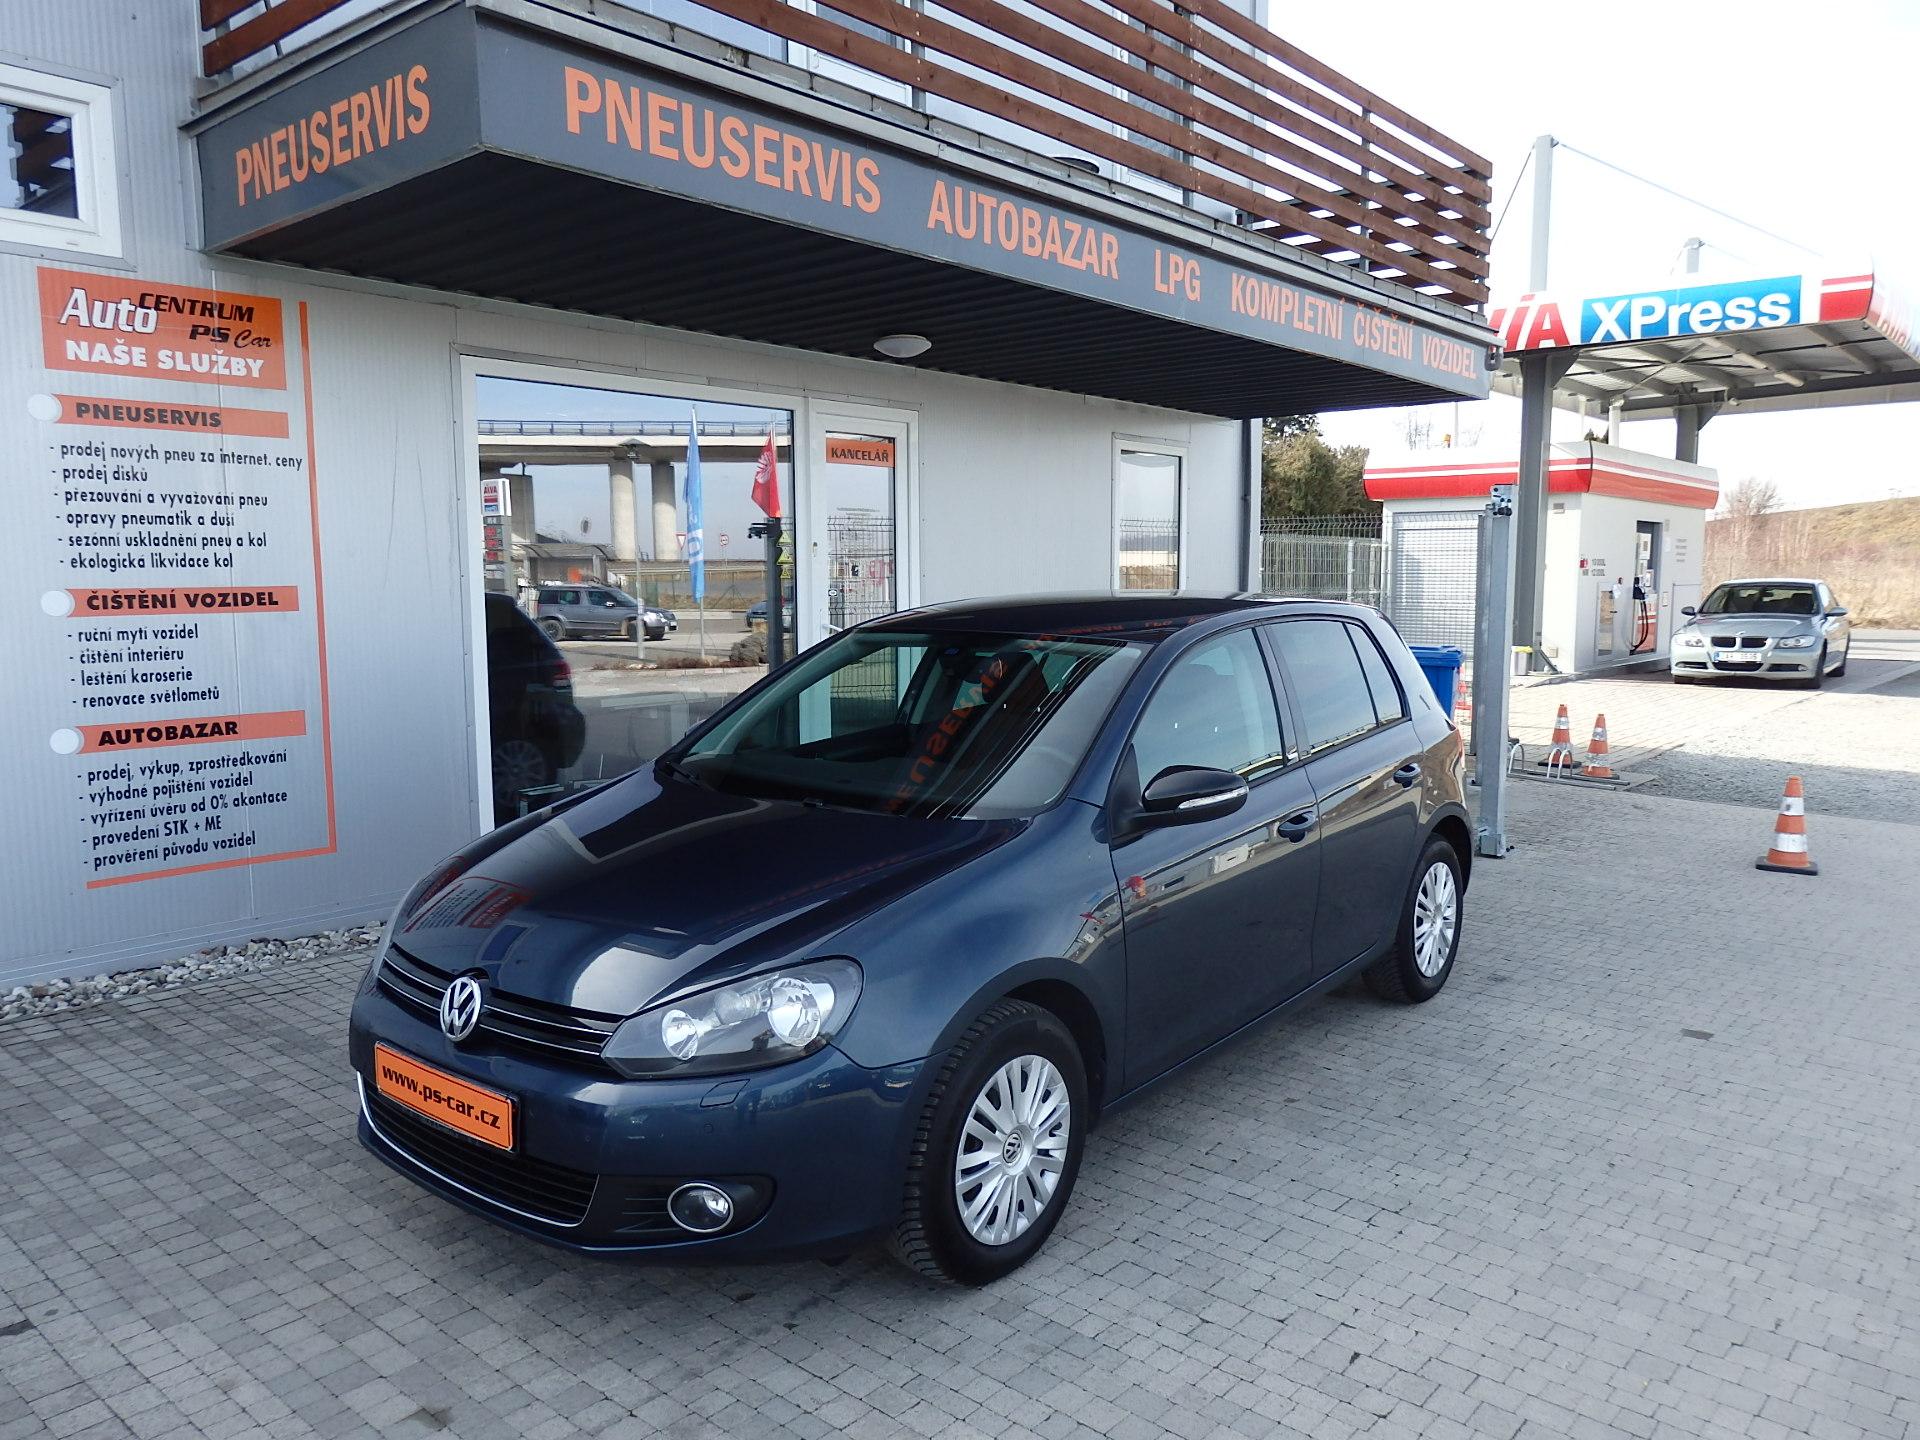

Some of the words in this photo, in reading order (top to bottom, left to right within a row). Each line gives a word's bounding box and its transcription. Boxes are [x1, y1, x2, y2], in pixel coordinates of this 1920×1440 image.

[235, 64, 431, 207] PNEUSERVIS
[564, 65, 882, 214] PNEUSERVIS
[927, 180, 1119, 280] AUTOBAZAR
[1154, 248, 1200, 302] LPG
[1231, 272, 1346, 341] KOMPLETNÍ
[1352, 301, 1415, 360] ČIŠTĚNÍ
[1422, 334, 1477, 380] VOZIDEL
[58, 287, 158, 334] Auto
[138, 292, 255, 323] CENTRUM
[189, 325, 230, 343] PS
[234, 329, 272, 349] Car
[65, 338, 147, 368] NAŠE
[157, 348, 264, 378] SLUŽBY
[75, 402, 222, 428] PNEUSERVIS
[61, 441, 106, 461] prodej
[110, 444, 159, 463] nových
[164, 450, 194, 464] pneu
[200, 452, 214, 462] za
[275, 456, 303, 471] ceny
[831, 447, 889, 463] KANCELÁŘ
[63, 464, 107, 484] prodej
[112, 465, 148, 482] disků
[65, 488, 141, 505] přezouvání
[147, 493, 154, 503] a
[161, 492, 234, 508] vyvažování
[239, 496, 267, 509] pneu
[67, 512, 115, 528] opravy
[122, 510, 191, 528] pneumatik
[198, 516, 205, 526] a
[211, 511, 234, 526] duší
[69, 532, 120, 547] sezónní
[126, 531, 196, 547] uskladnění
[202, 536, 231, 550] pneu
[236, 537, 243, 547] a
[248, 531, 266, 547] kol
[70, 553, 145, 572] ekologická
[151, 553, 209, 568] likvidace
[214, 552, 233, 568] kol
[86, 589, 177, 611] ČIŠTĚNÍ
[184, 591, 279, 608] VOZIDEL
[78, 627, 112, 642] ruční
[117, 626, 148, 644] mytí
[152, 623, 199, 640] vozidel
[80, 648, 123, 664] čištění
[128, 645, 184, 662] interiéru
[81, 669, 126, 686] leštění
[131, 666, 193, 683] karoserie
[83, 694, 145, 708] renovace
[150, 686, 220, 704] světlometů
[98, 721, 239, 747] AUTOBAZAR
[88, 763, 134, 786] prodej,
[140, 760, 184, 779] výkup,
[189, 749, 287, 775] zprostředkování
[89, 783, 148, 807] výhodné
[153, 777, 205, 800] pojištění
[210, 771, 253, 790] vozidel
[91, 805, 146, 828] vyřízení
[150, 802, 186, 818] úvěru
[191, 797, 206, 812] od
[210, 794, 228, 809] 0%
[233, 792, 288, 807] akontace
[92, 824, 160, 850] provedení
[164, 819, 189, 836] STK
[205, 815, 222, 831] ME
[94, 845, 158, 871] prověření
[163, 838, 208, 861] původu
[213, 830, 256, 850] vozidel
[382, 1061, 501, 1131] www.ps-car.cz
